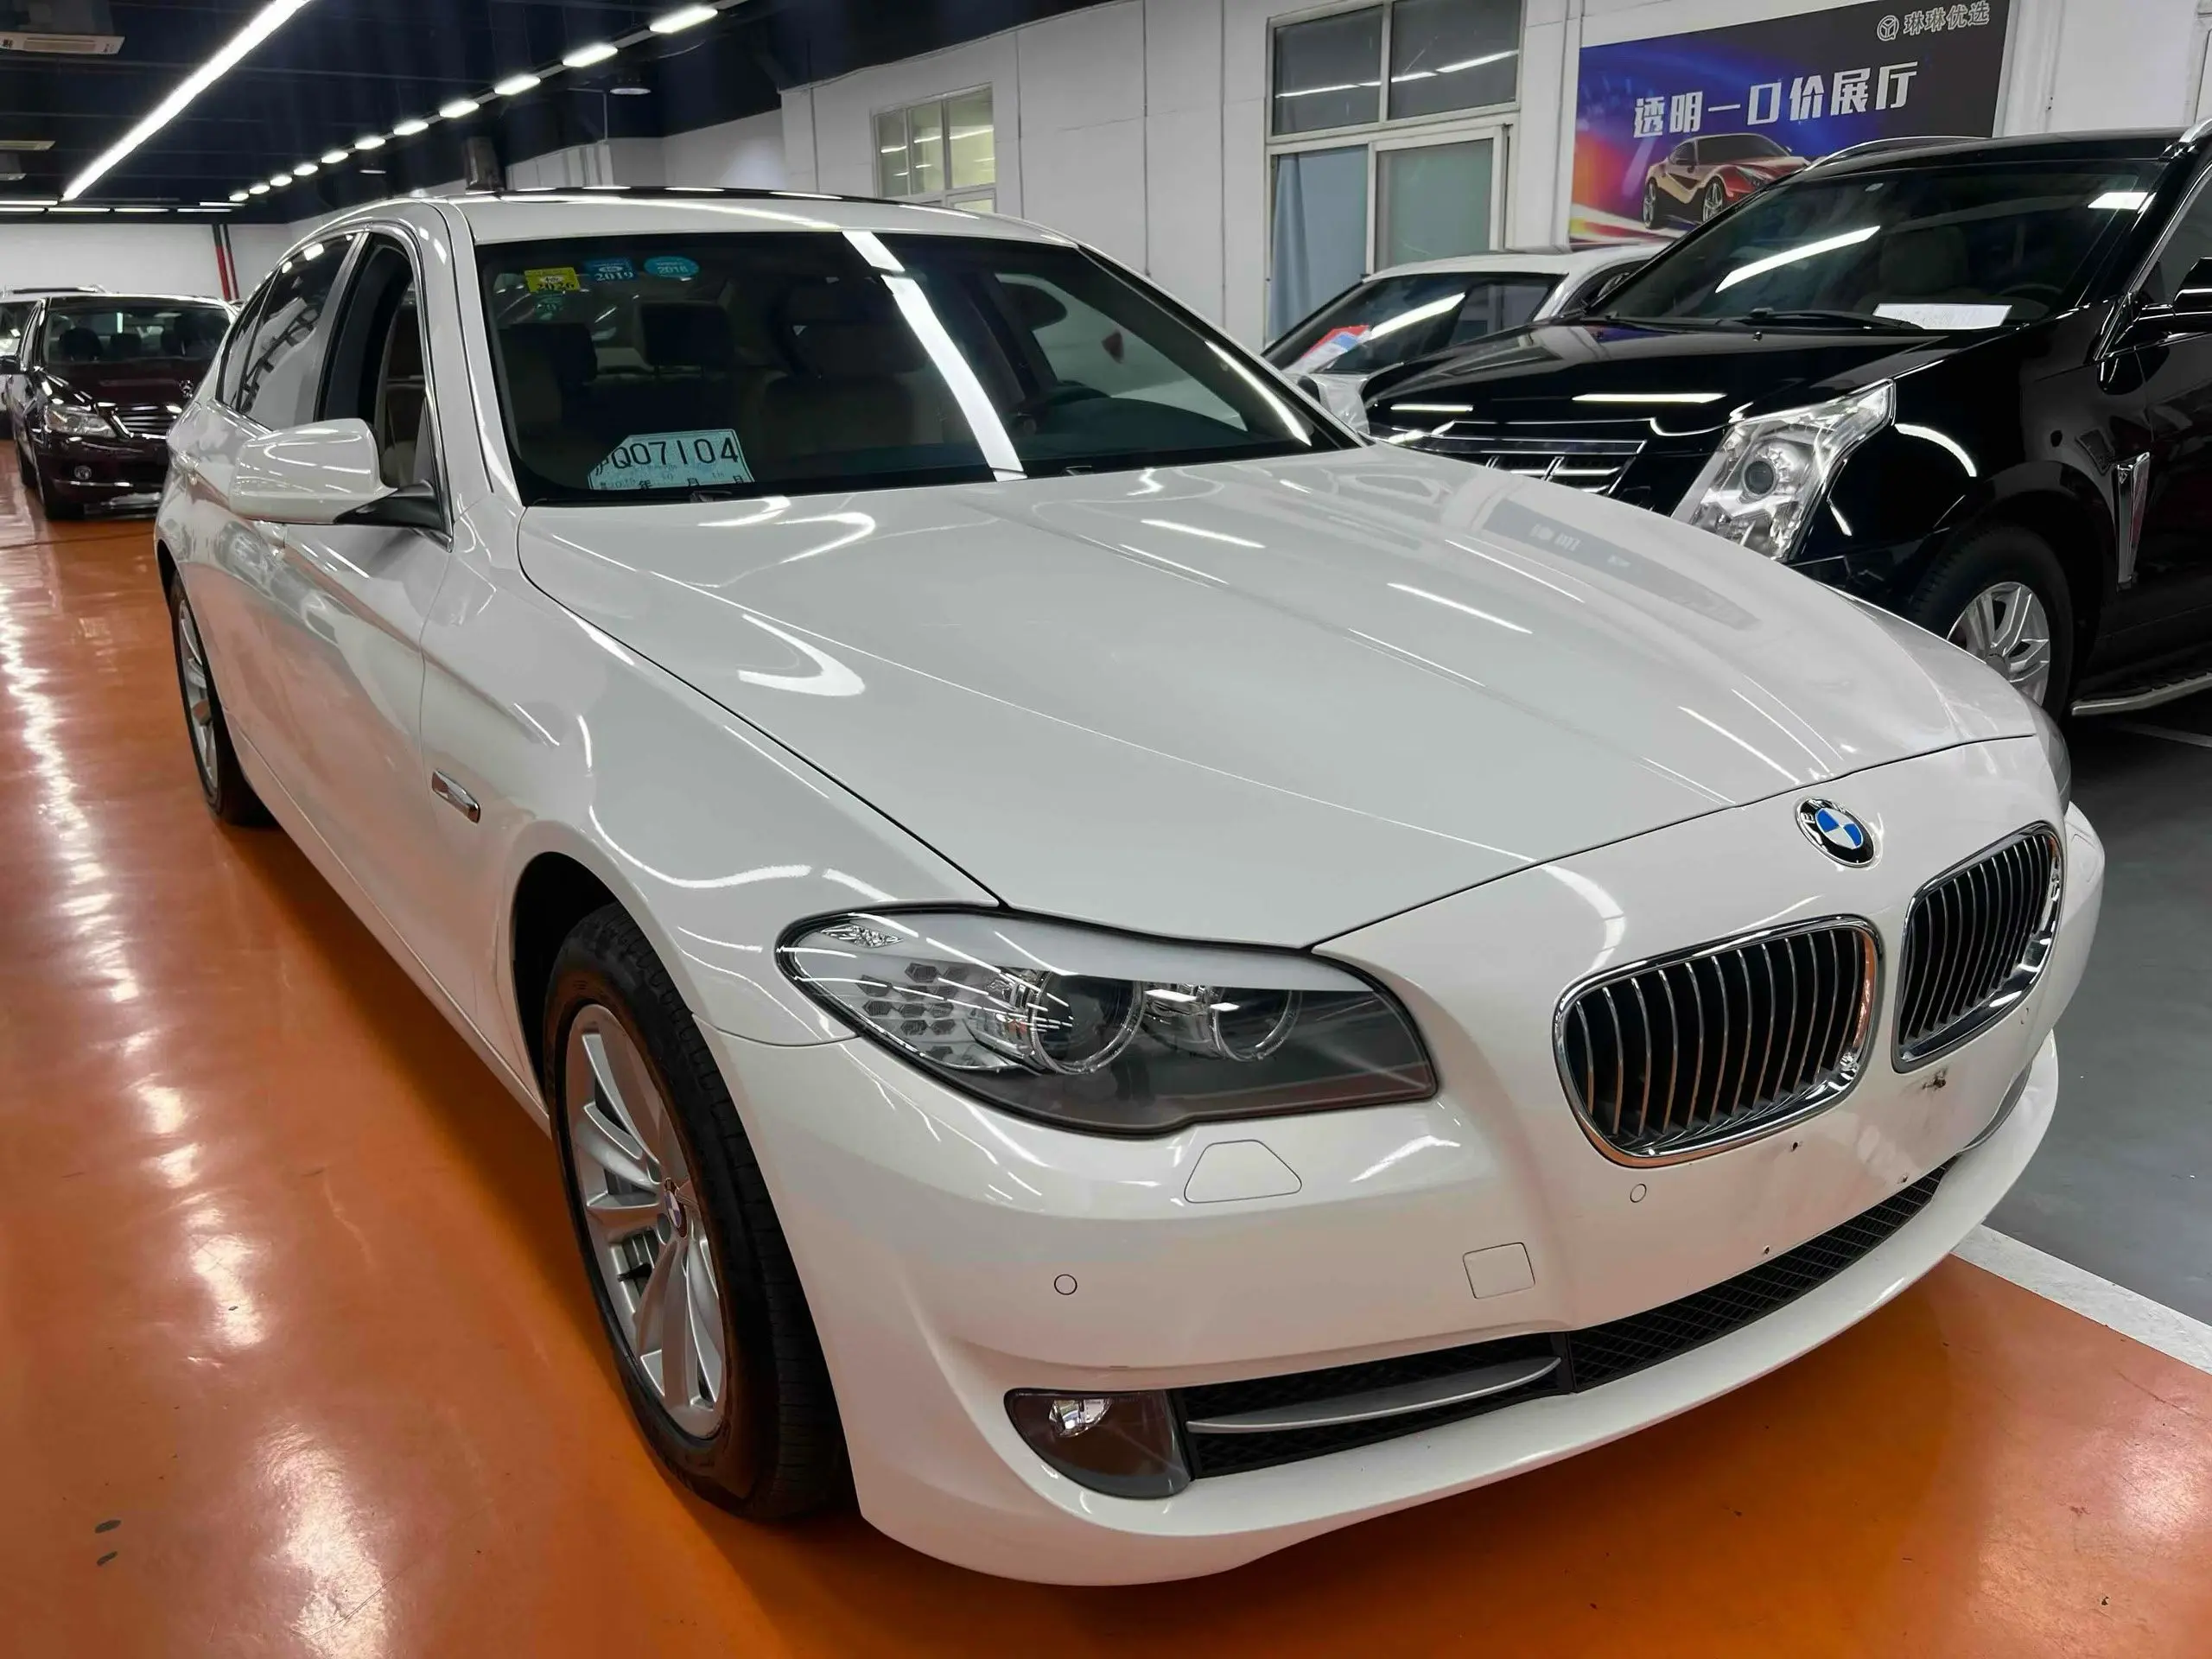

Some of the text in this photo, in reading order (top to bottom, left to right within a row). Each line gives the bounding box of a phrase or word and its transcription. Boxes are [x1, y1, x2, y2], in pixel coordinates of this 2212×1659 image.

[1903, 0, 1990, 35] 琳琳优选
[1633, 61, 1918, 138] 透明一口价展厅
[594, 270, 633, 281] 2019
